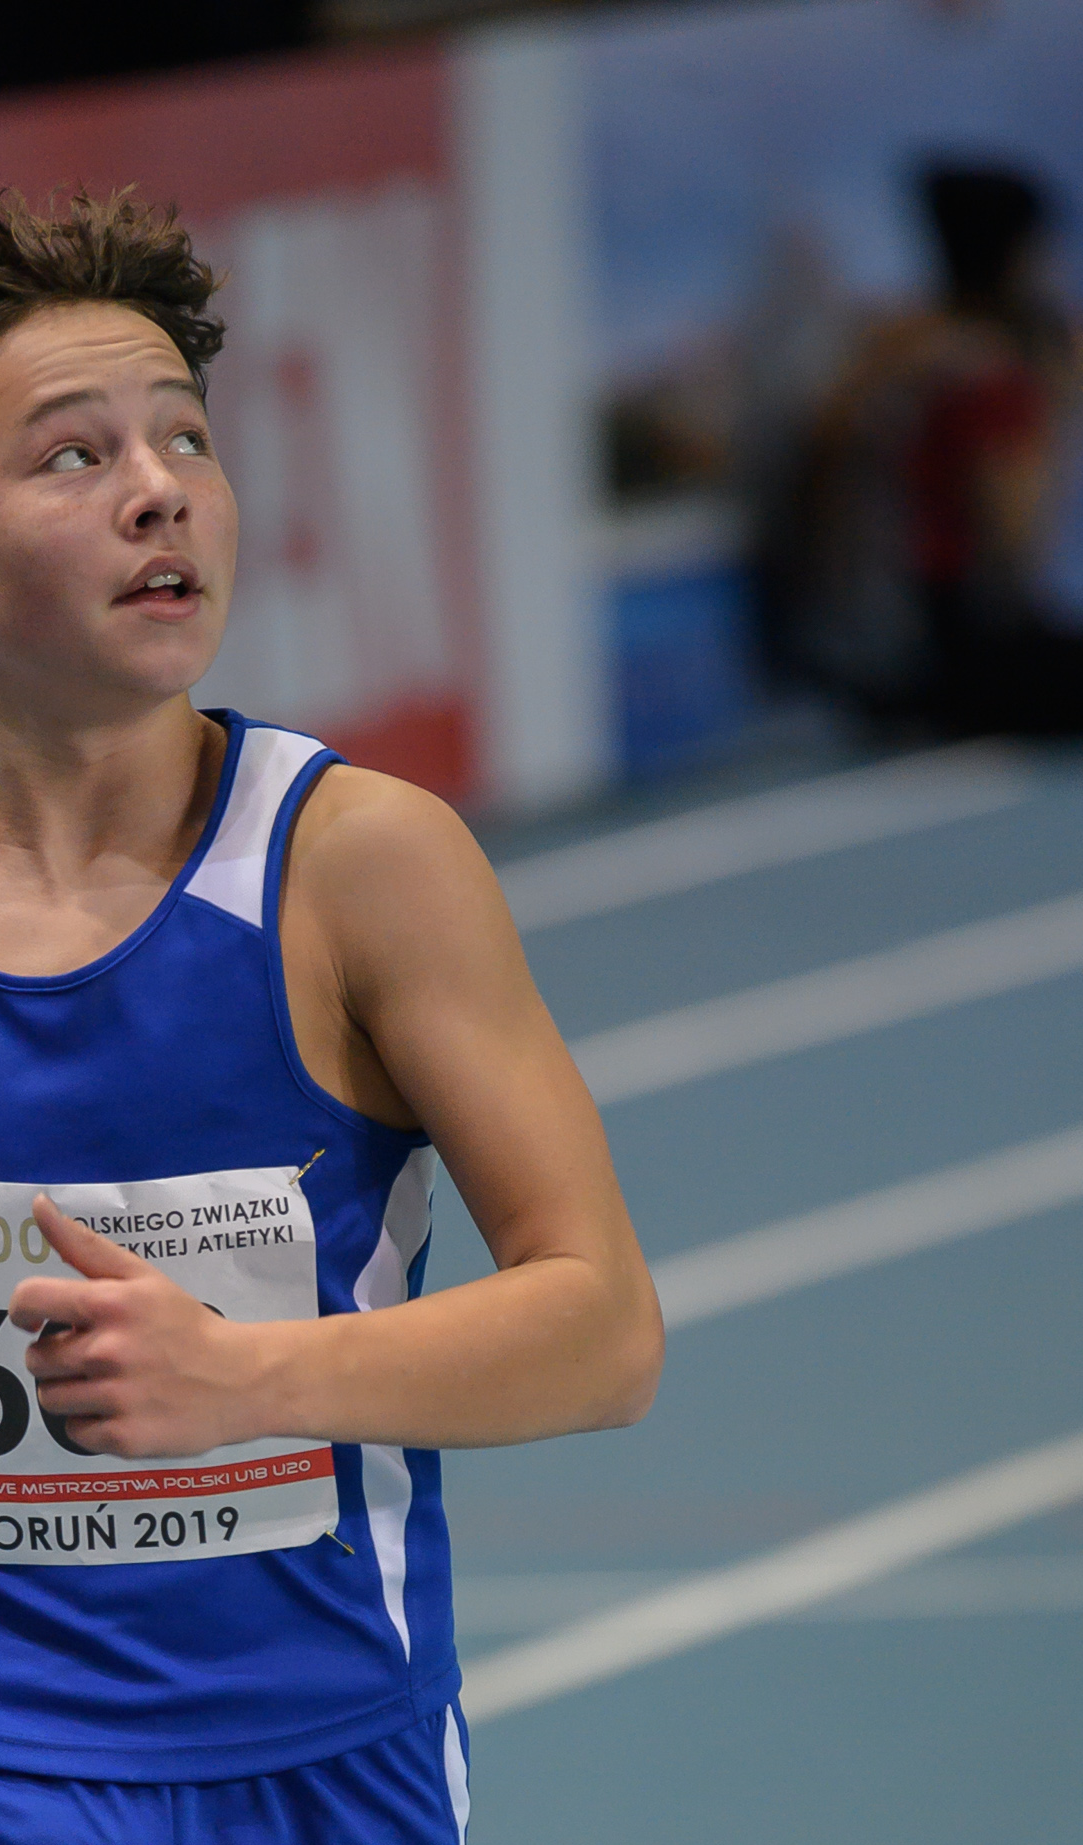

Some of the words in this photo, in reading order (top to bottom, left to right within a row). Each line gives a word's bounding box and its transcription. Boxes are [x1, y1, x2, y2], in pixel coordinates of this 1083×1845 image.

[190, 1196, 290, 1227] ZWIĄZKU
[116, 1238, 188, 1260] KKIEJ
[196, 1224, 294, 1255] ATLETYKI
[21, 1478, 160, 1495] MISTRZOSTWA
[164, 1472, 230, 1490] POLSKI
[234, 1466, 268, 1483] U18
[272, 1459, 312, 1477] U20
[133, 1506, 239, 1549] 2019
